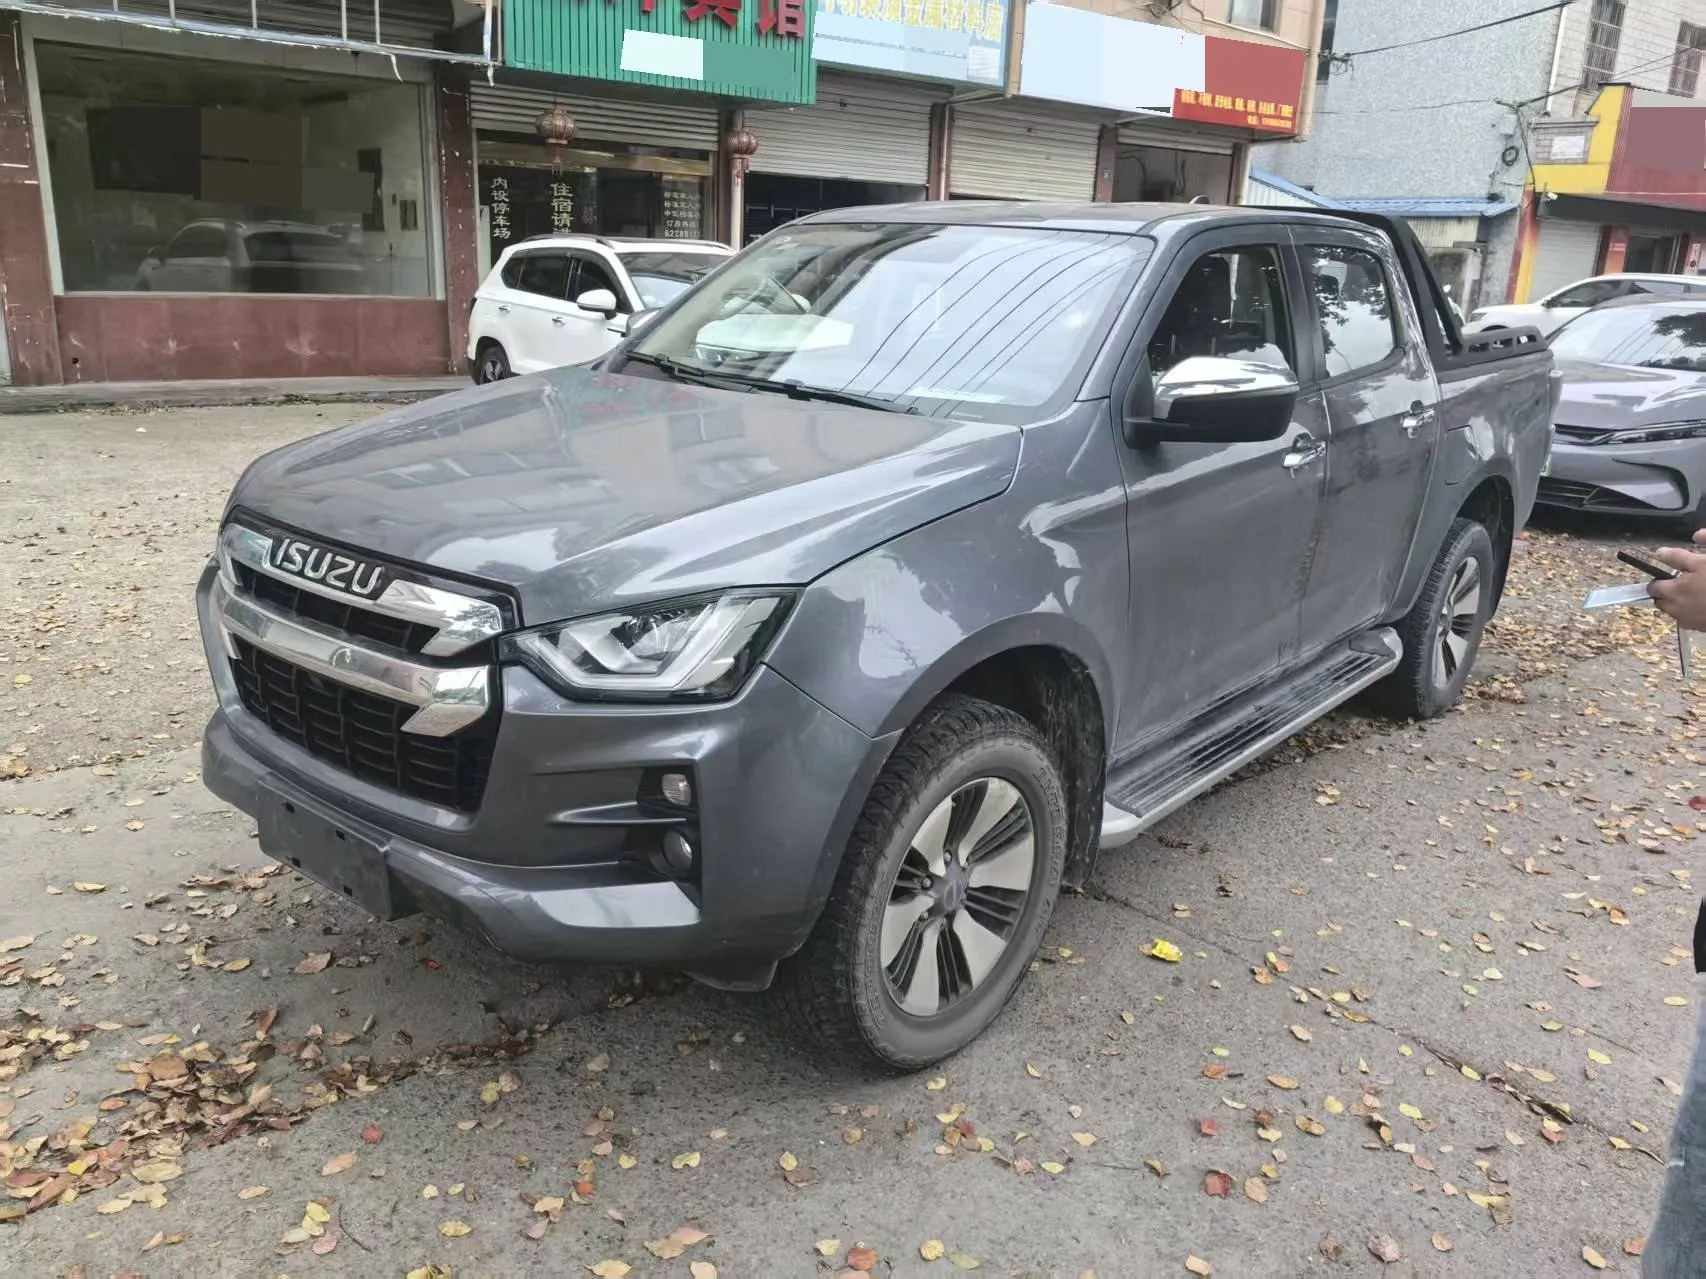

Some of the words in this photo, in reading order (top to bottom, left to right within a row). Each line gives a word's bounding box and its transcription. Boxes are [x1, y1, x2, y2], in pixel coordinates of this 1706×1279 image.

[491, 177, 511, 239] 内设停车场
[275, 538, 382, 595] ISUZU
